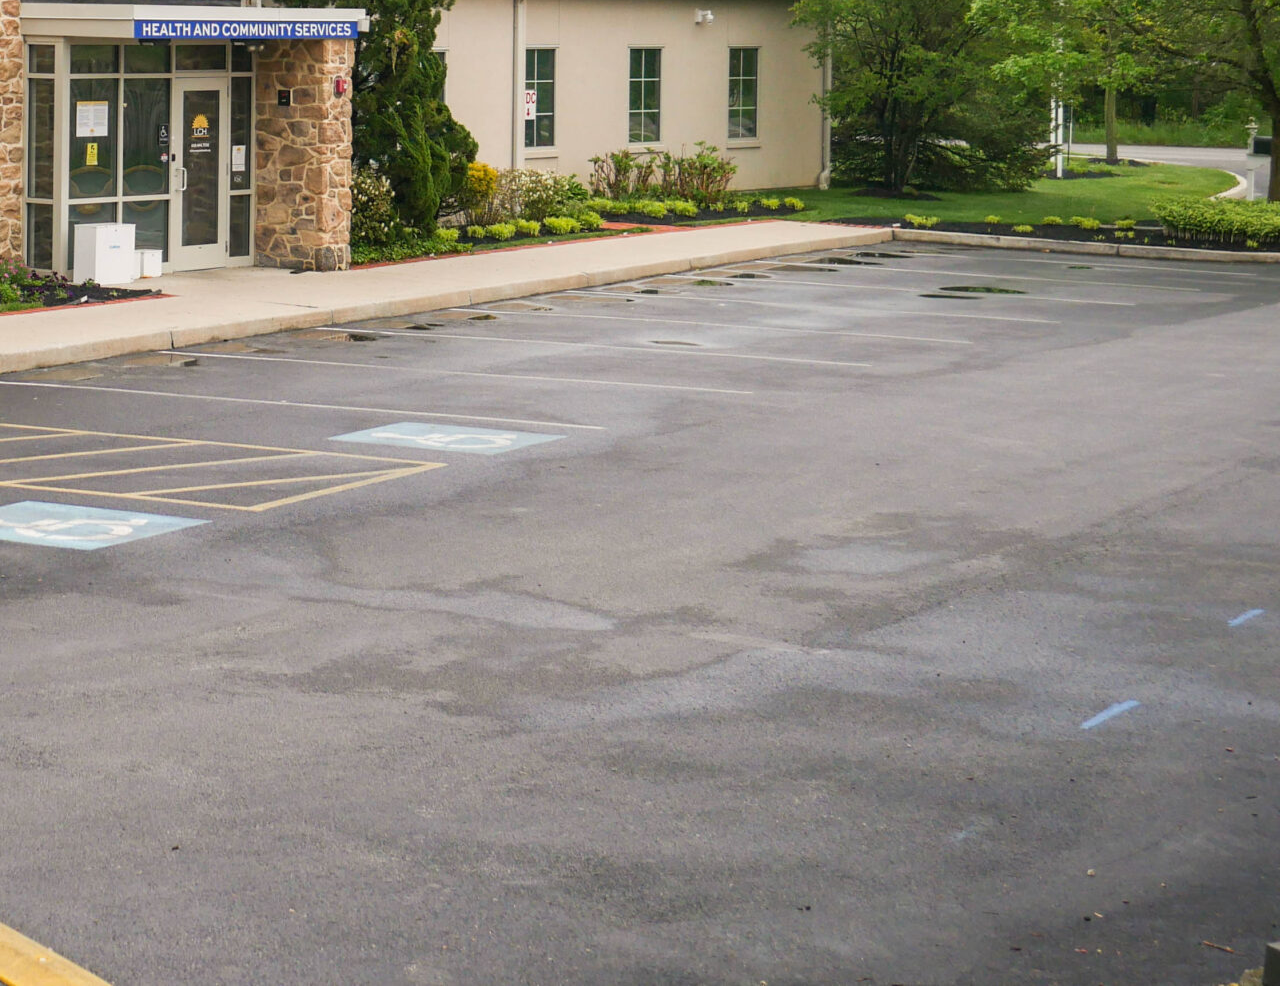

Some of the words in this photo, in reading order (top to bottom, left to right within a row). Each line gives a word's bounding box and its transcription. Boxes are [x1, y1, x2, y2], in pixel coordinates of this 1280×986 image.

[142, 22, 191, 36] HEALTH
[193, 22, 219, 36] AND
[222, 23, 293, 36] COMMUNITY
[295, 23, 352, 36] SERVICES
[525, 92, 536, 104] DC
[193, 127, 208, 136] LCH
